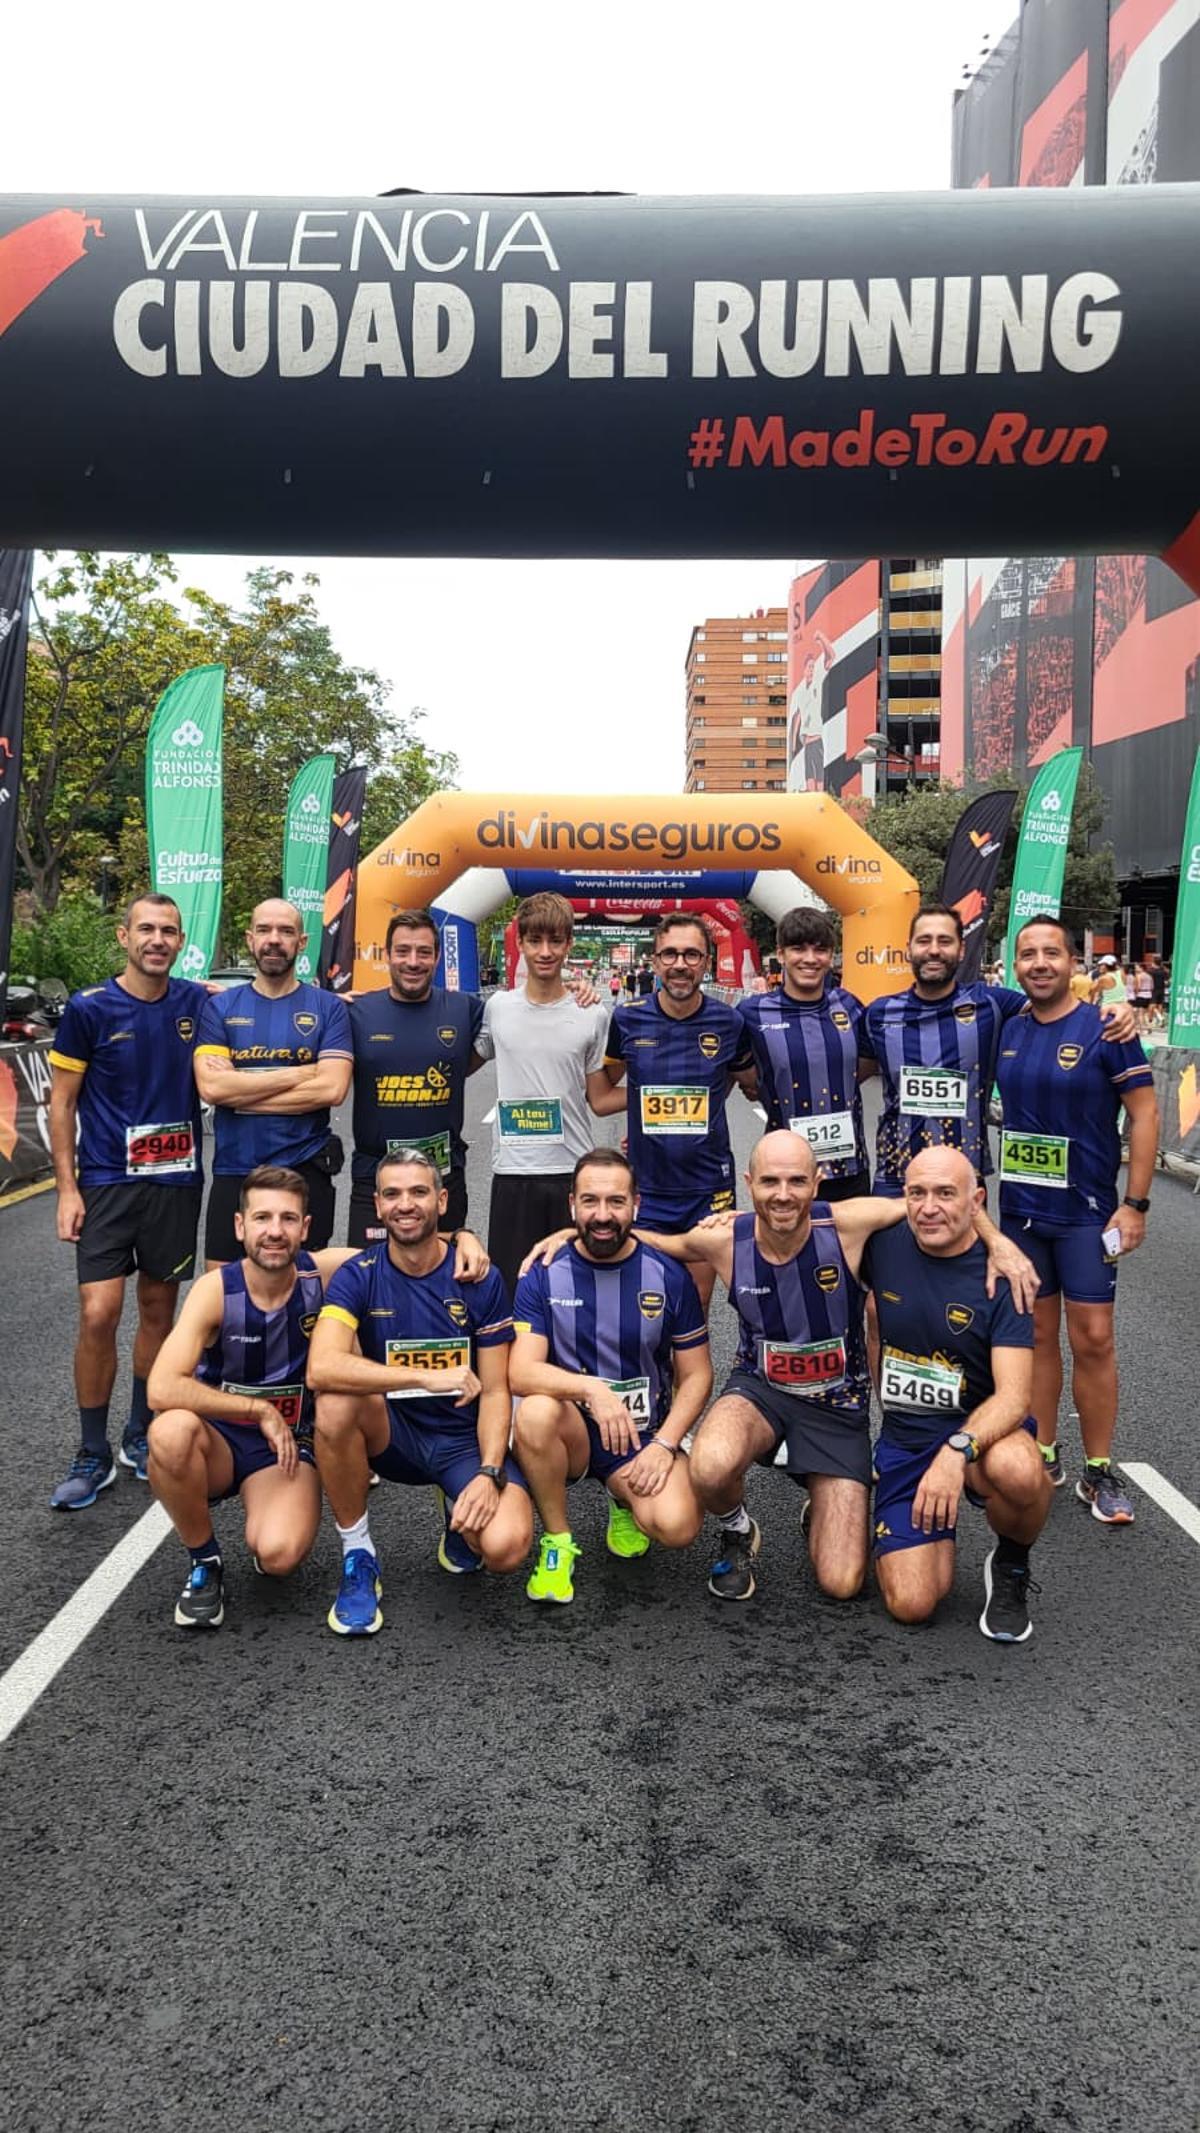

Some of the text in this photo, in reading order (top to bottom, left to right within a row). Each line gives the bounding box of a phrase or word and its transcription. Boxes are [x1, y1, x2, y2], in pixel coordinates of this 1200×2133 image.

[133, 208, 561, 272] VALENCIA
[113, 272, 1123, 378] CIUDAD DEL RUNNING
[687, 409, 1108, 469] #MadeToRun
[154, 750, 221, 759] FUNDACIÓ
[477, 810, 781, 860] divinaseguros
[158, 851, 209, 867] Cultua
[377, 848, 440, 866] divina
[816, 855, 881, 874] divina
[575, 880, 686, 891] www.intersport.es
[377, 1076, 425, 1089] JOCS
[906, 1079, 961, 1099] 6551
[377, 1088, 451, 1102] TARONJA
[648, 1097, 703, 1115] 3917
[807, 1123, 842, 1142] 512
[130, 1133, 191, 1156] 2940
[1007, 1143, 1062, 1168] 4351
[394, 1350, 463, 1371] 3551
[771, 1352, 840, 1376] 2610
[885, 1373, 954, 1408] 5469
